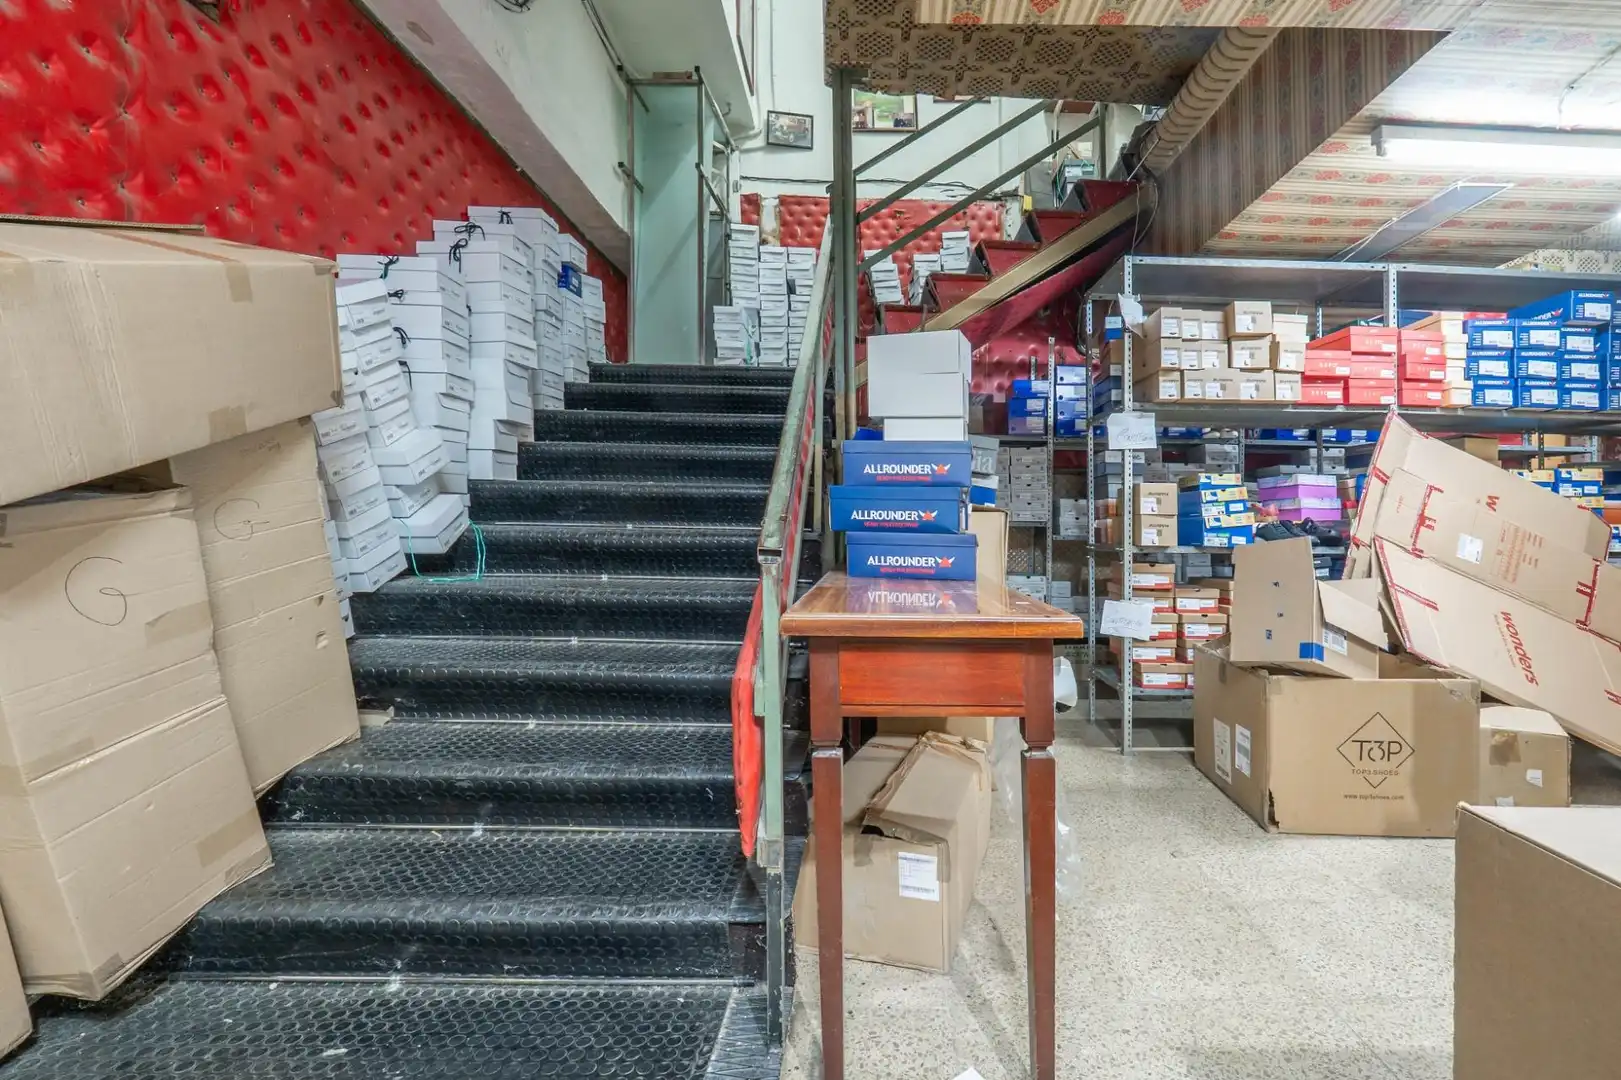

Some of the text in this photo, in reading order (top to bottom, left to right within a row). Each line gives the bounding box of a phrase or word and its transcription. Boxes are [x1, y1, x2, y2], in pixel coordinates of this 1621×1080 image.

[863, 463, 932, 475] ALLROUNDER
[851, 509, 919, 521] ALLROUNDER
[867, 555, 936, 567] ALLROUNDER
[1500, 610, 1539, 687] wonders
